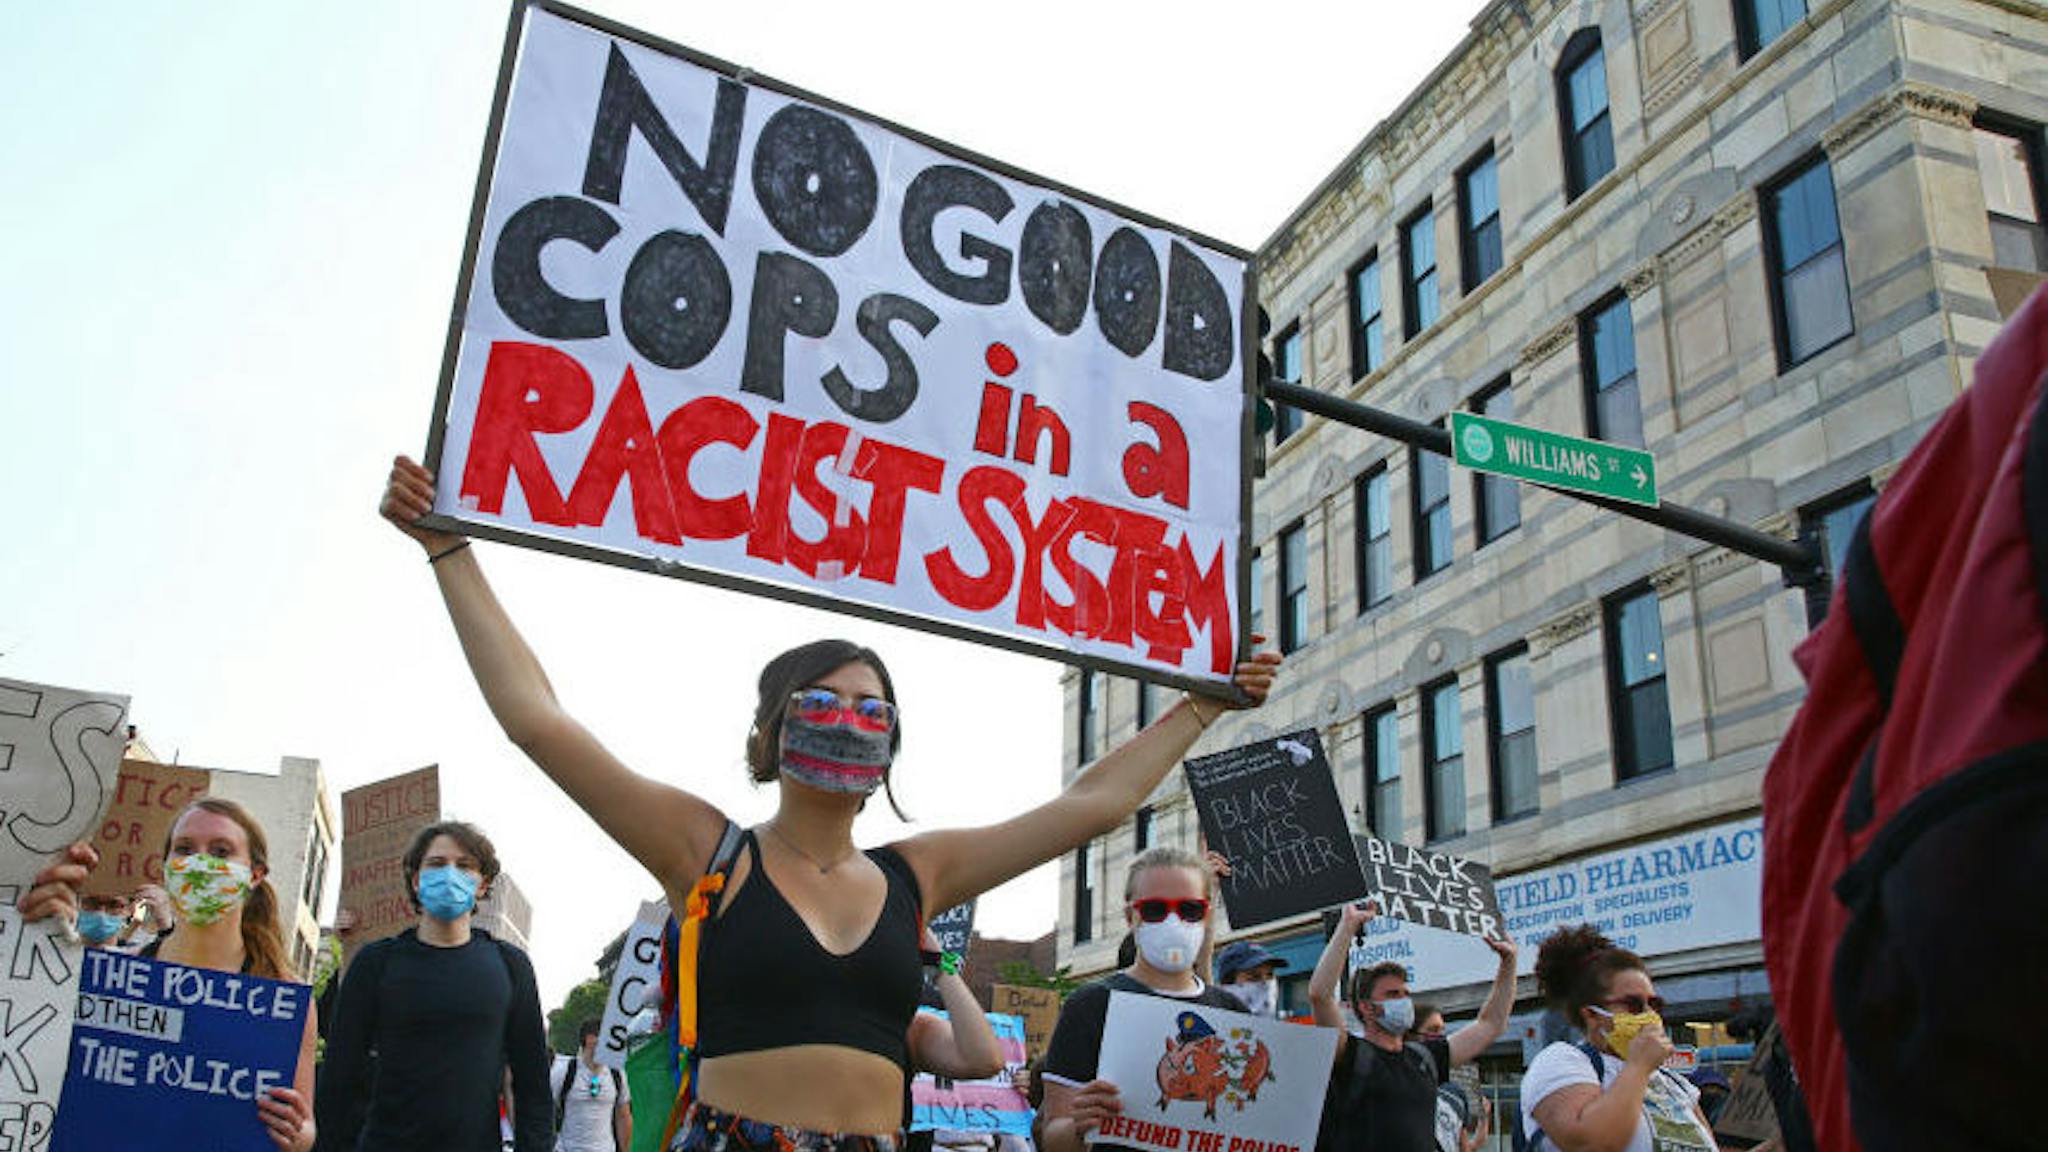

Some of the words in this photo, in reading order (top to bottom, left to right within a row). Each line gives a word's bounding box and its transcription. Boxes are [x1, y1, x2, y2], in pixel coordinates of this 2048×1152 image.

[581, 40, 878, 257] NO
[901, 164, 1233, 381] GOOD
[492, 195, 940, 423] COPS
[973, 341, 1071, 477] in
[1122, 400, 1190, 511] a
[460, 340, 944, 585] RACIST
[1505, 436, 1600, 481] WILLIAMS
[345, 775, 438, 836] JUSTICE
[1211, 777, 1309, 831] BLACK
[102, 821, 142, 846] OR
[1222, 812, 1308, 860] LIVES
[1231, 836, 1346, 895] MATTER
[1367, 838, 1476, 884] BLACK
[1375, 864, 1484, 911] LIVES
[1506, 903, 1584, 932] ESCRIPTION
[1594, 882, 1690, 914] SPECIALISTS
[1622, 904, 1693, 929] DELIVERY
[88, 952, 151, 998] THE
[163, 967, 297, 1020] POLICE
[78, 1037, 139, 1087] THE
[146, 1051, 281, 1100] POLICE
[1099, 1115, 1182, 1149] DEFUND
[1187, 1129, 1226, 1152] THE
